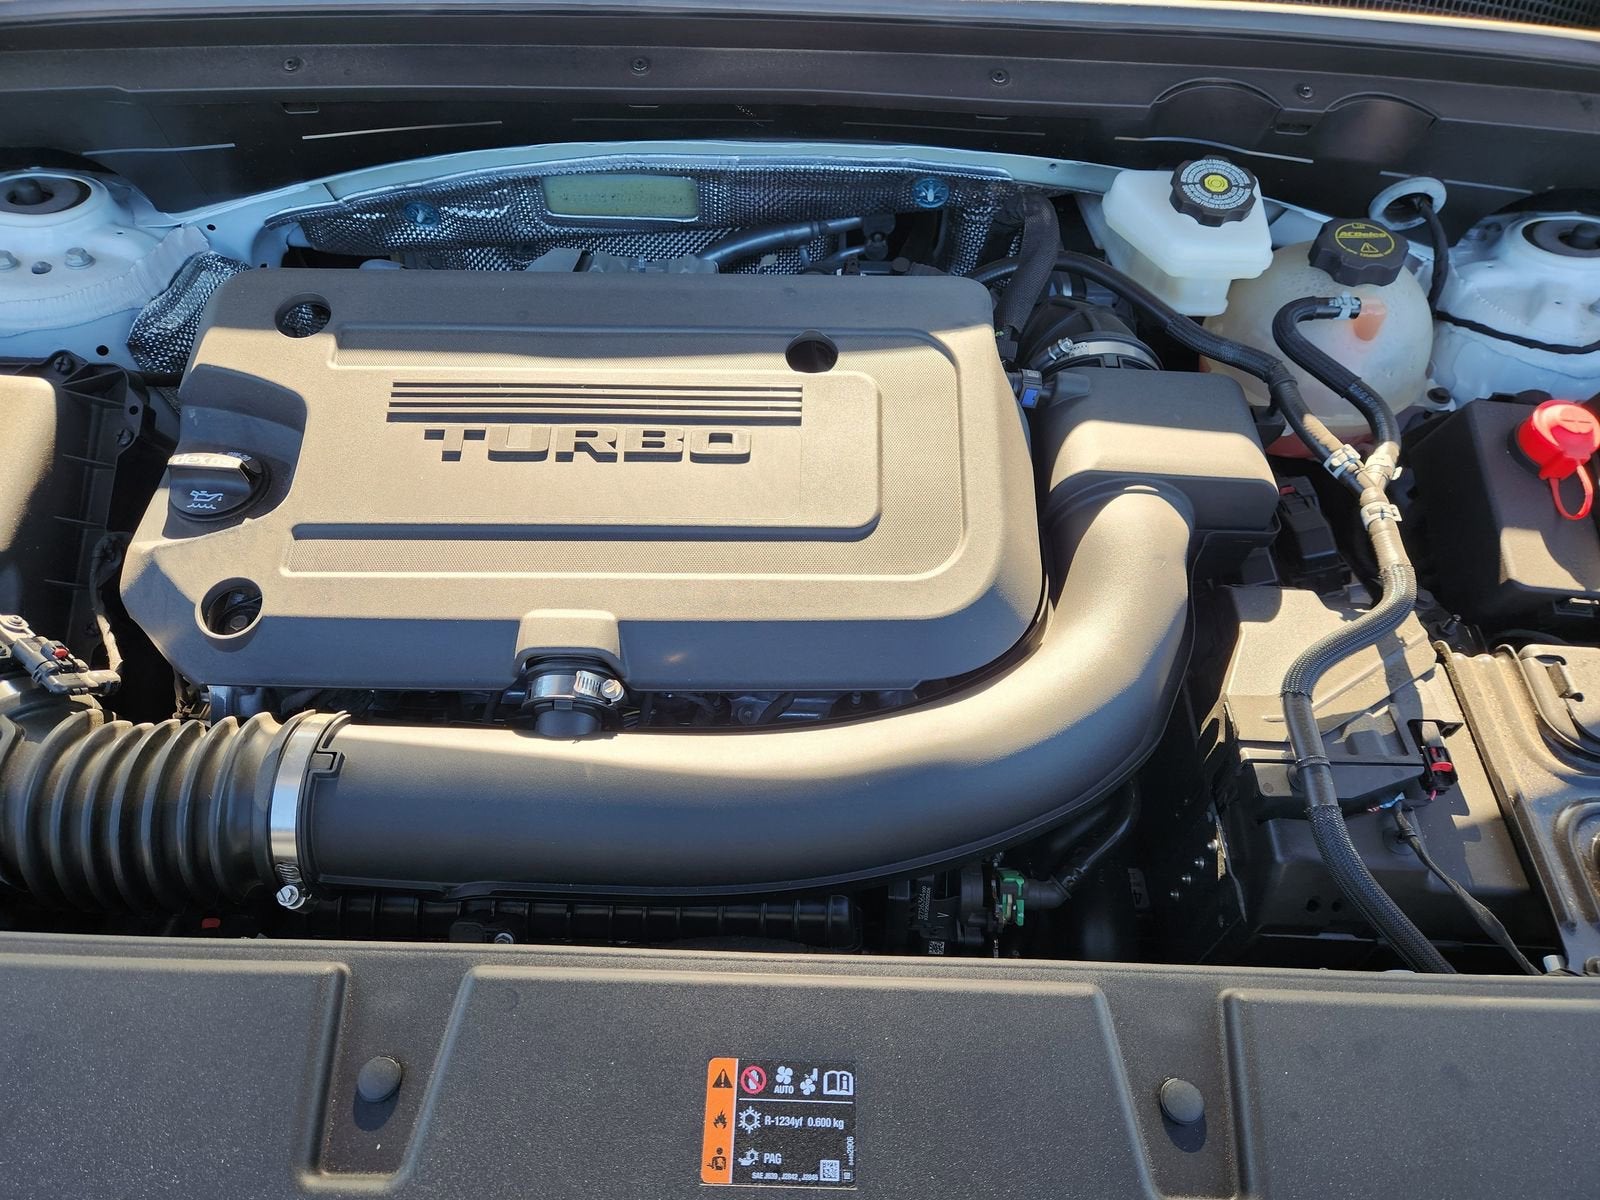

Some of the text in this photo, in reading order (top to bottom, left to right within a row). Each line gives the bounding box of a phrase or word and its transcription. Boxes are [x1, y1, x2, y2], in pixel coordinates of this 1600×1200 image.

[424, 426, 752, 464] TURBO
[773, 1085, 794, 1094] AUTO
[764, 1115, 845, 1130] R-1234yf 0.600 kg
[763, 1152, 782, 1165] PAG
